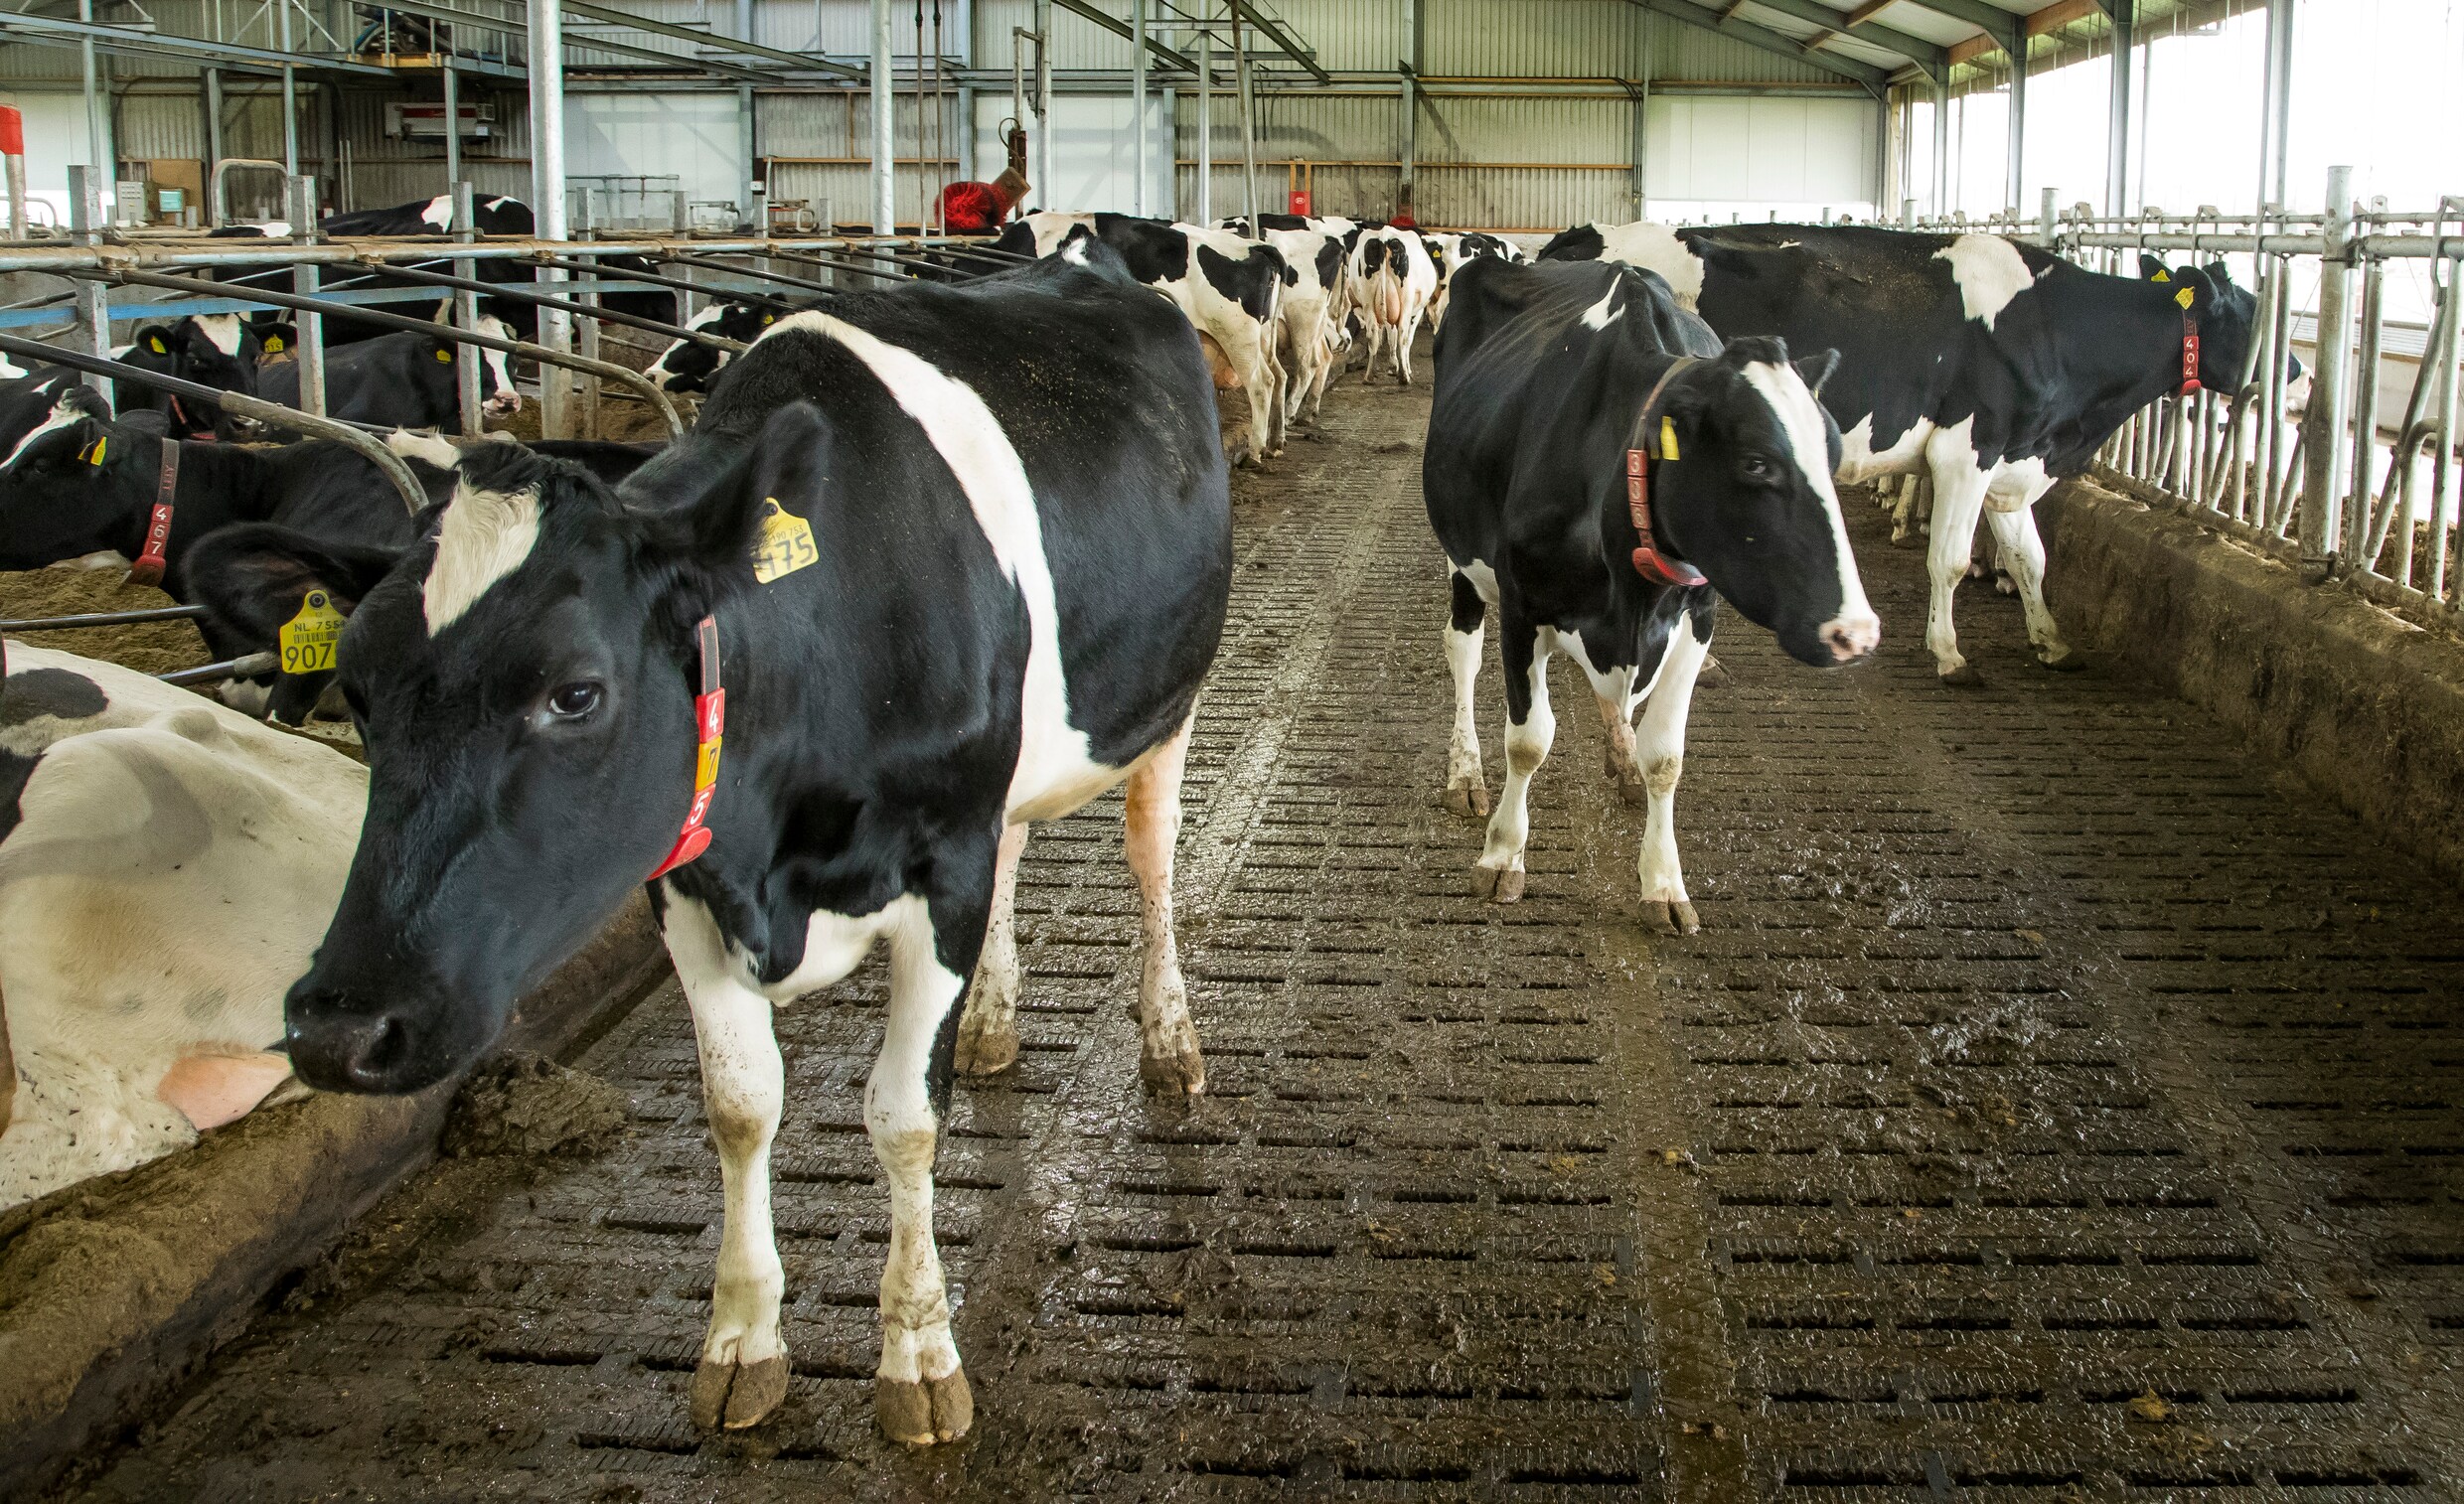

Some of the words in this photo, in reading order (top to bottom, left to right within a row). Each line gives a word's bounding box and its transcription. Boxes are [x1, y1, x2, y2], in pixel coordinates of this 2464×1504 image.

[2186, 339, 2196, 376] 404
[151, 507, 167, 554] 467
[294, 623, 310, 633] NL
[285, 642, 333, 672] 907
[690, 697, 719, 826] 475
